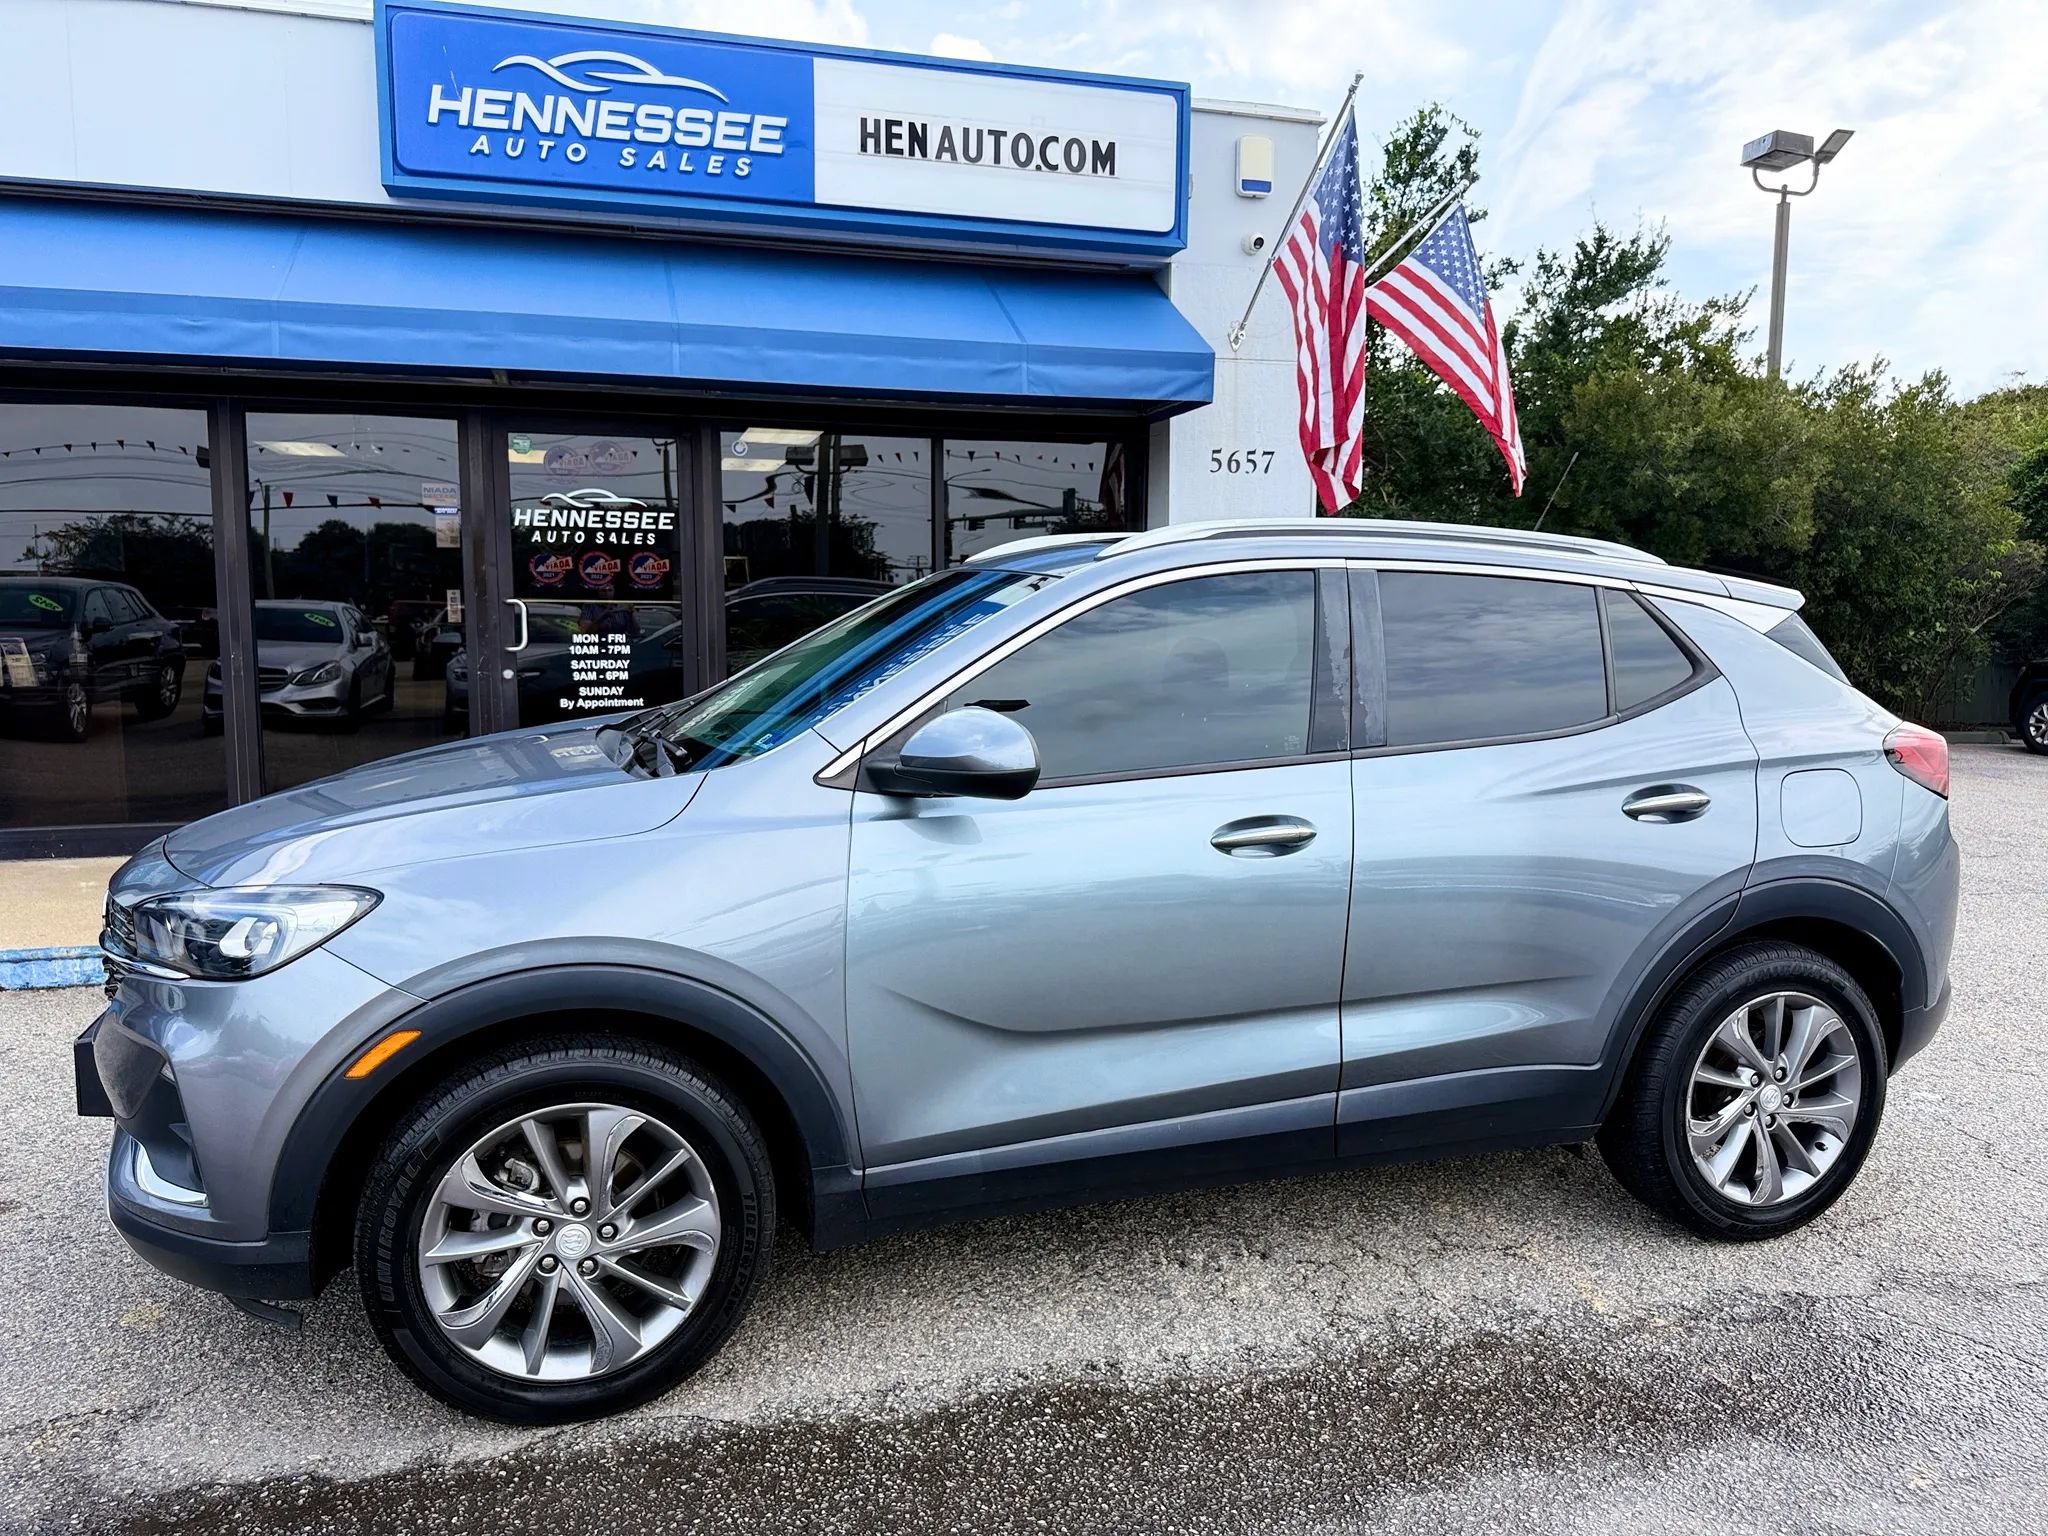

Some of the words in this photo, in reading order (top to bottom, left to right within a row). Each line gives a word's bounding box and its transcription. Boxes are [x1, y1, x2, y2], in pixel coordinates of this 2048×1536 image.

[427, 84, 788, 154] HENNESSEE
[860, 117, 1116, 176] HENAUTO.COM
[470, 135, 587, 163] AUTO
[620, 148, 752, 176] SALES
[1209, 448, 1275, 474] 5657
[514, 509, 675, 530] HENNESSEE
[531, 531, 585, 543] AUTO
[595, 532, 656, 545] SALES
[572, 633, 599, 643] MON
[608, 633, 626, 643] FRI
[569, 645, 599, 655] 10AM
[607, 645, 631, 654] 7PM
[570, 660, 630, 669] SATURDAY
[572, 671, 597, 680] 9AM
[605, 671, 629, 680] 6PM
[579, 686, 624, 696] SUNDAY
[560, 698, 574, 710] By
[576, 697, 644, 709] Appointment
[377, 1163, 421, 1302] UNIROYAL
